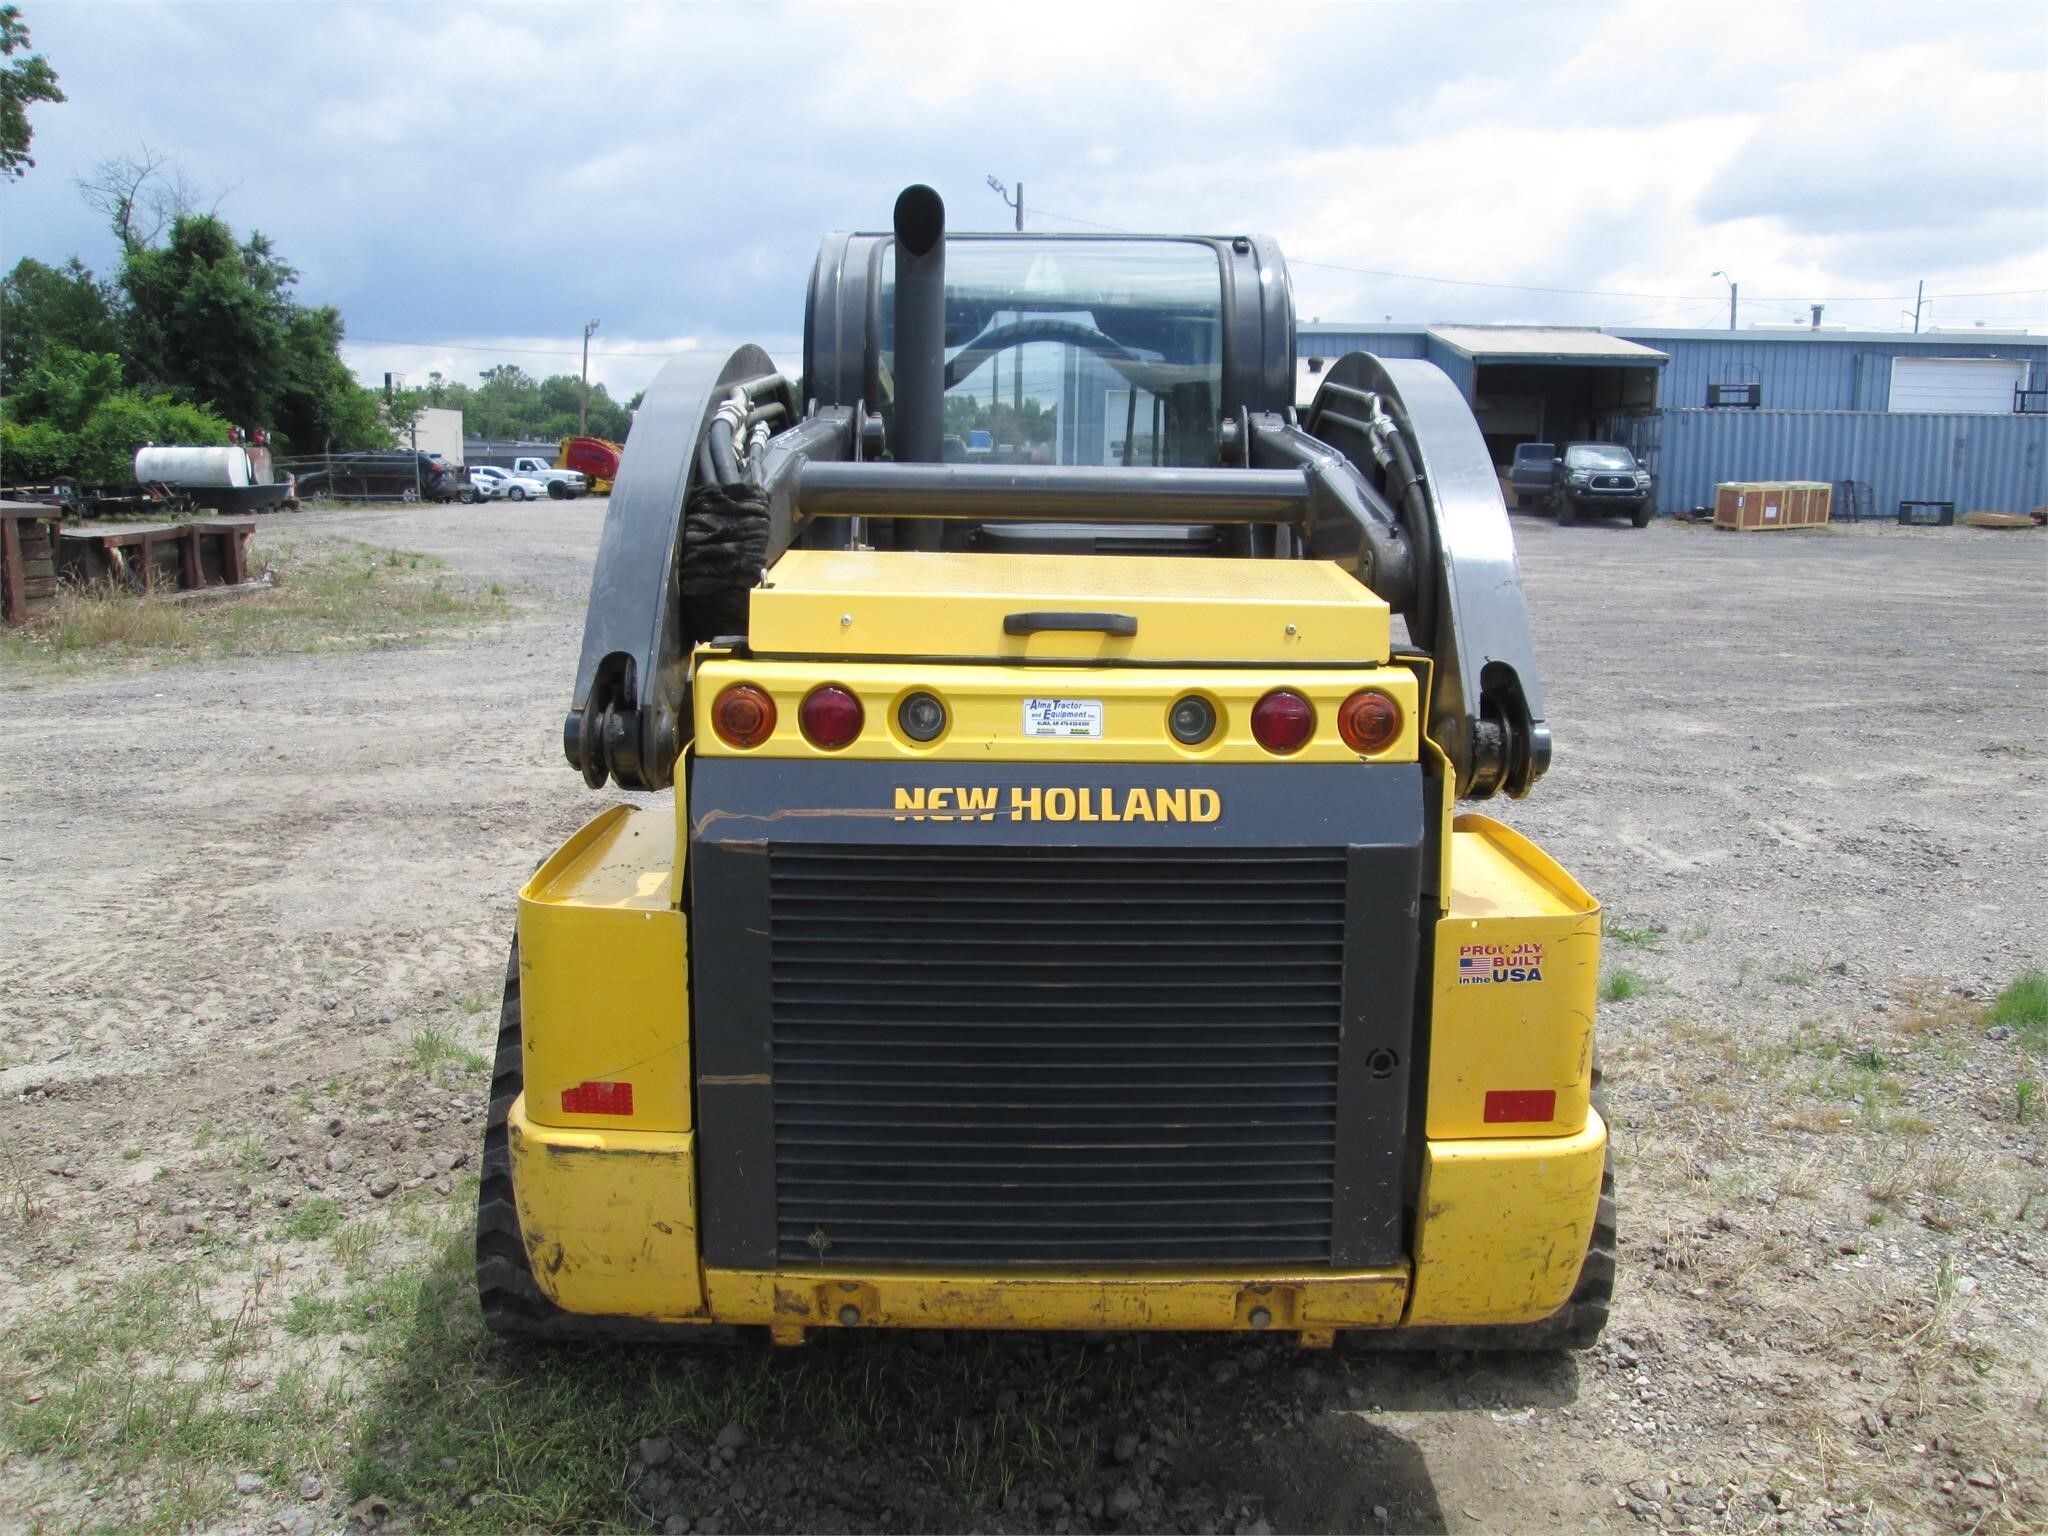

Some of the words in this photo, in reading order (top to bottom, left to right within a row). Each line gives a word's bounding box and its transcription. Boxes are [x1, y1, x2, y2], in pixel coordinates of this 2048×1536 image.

[1029, 699, 1051, 710] Alma
[1053, 699, 1082, 710] Tractor
[1043, 709, 1087, 720] Equipment
[894, 787, 999, 821] NEW
[1011, 787, 1221, 822] HOLLAND
[1493, 956, 1543, 967] BUILT
[1459, 976, 1470, 984] in
[1472, 976, 1491, 984] the
[1493, 968, 1542, 983] USA
